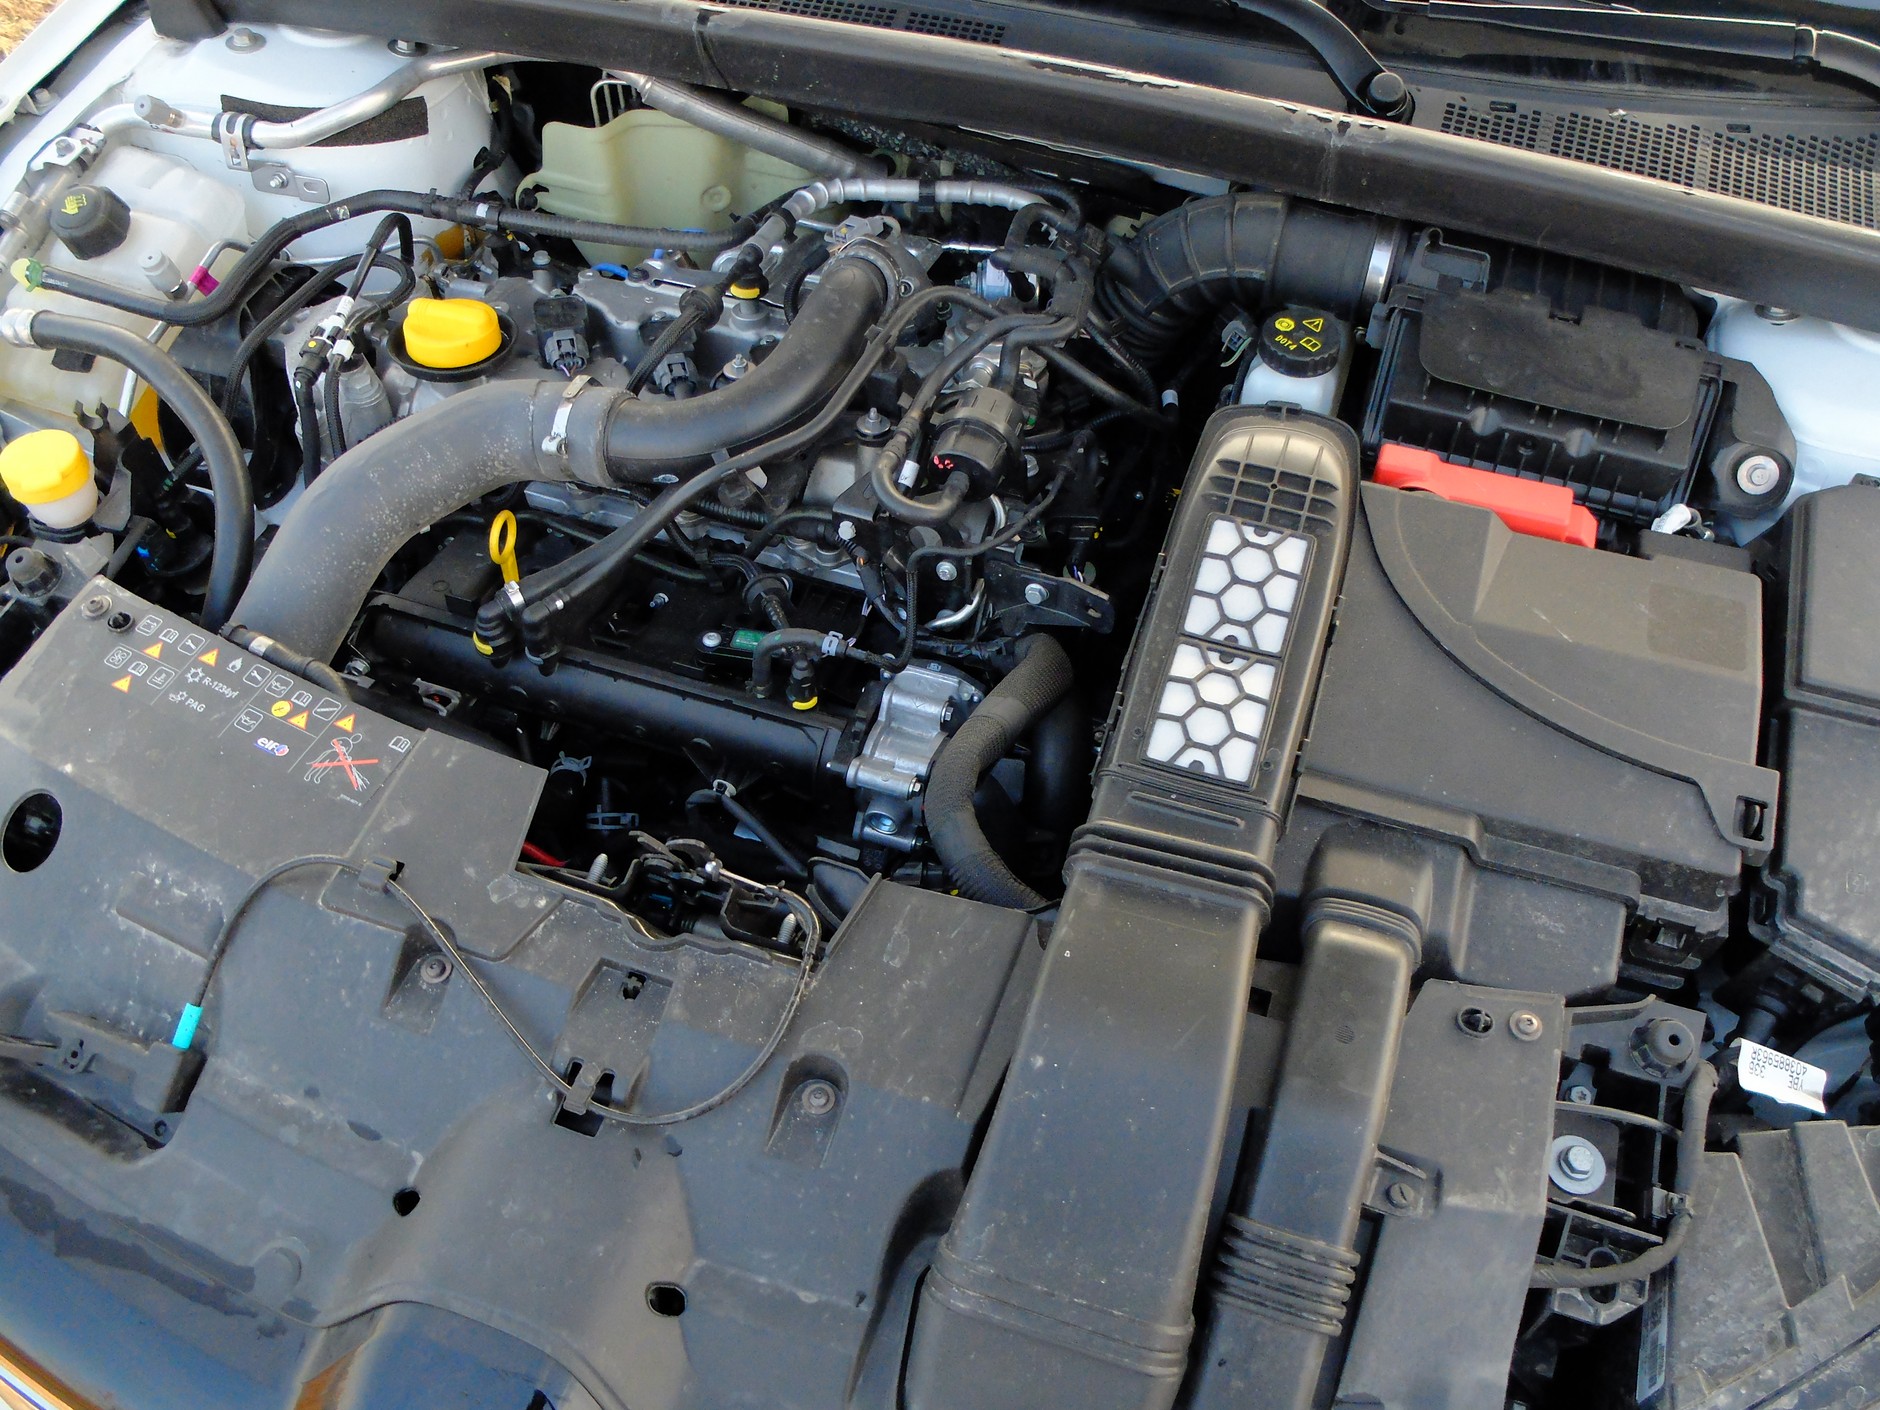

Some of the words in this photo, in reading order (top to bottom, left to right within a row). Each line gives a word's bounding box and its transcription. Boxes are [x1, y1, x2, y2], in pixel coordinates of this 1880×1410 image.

[202, 676, 240, 699] R-1234yf
[185, 698, 206, 713] PAG
[256, 737, 282, 753] elf
[1787, 1074, 1804, 1092] YBE
